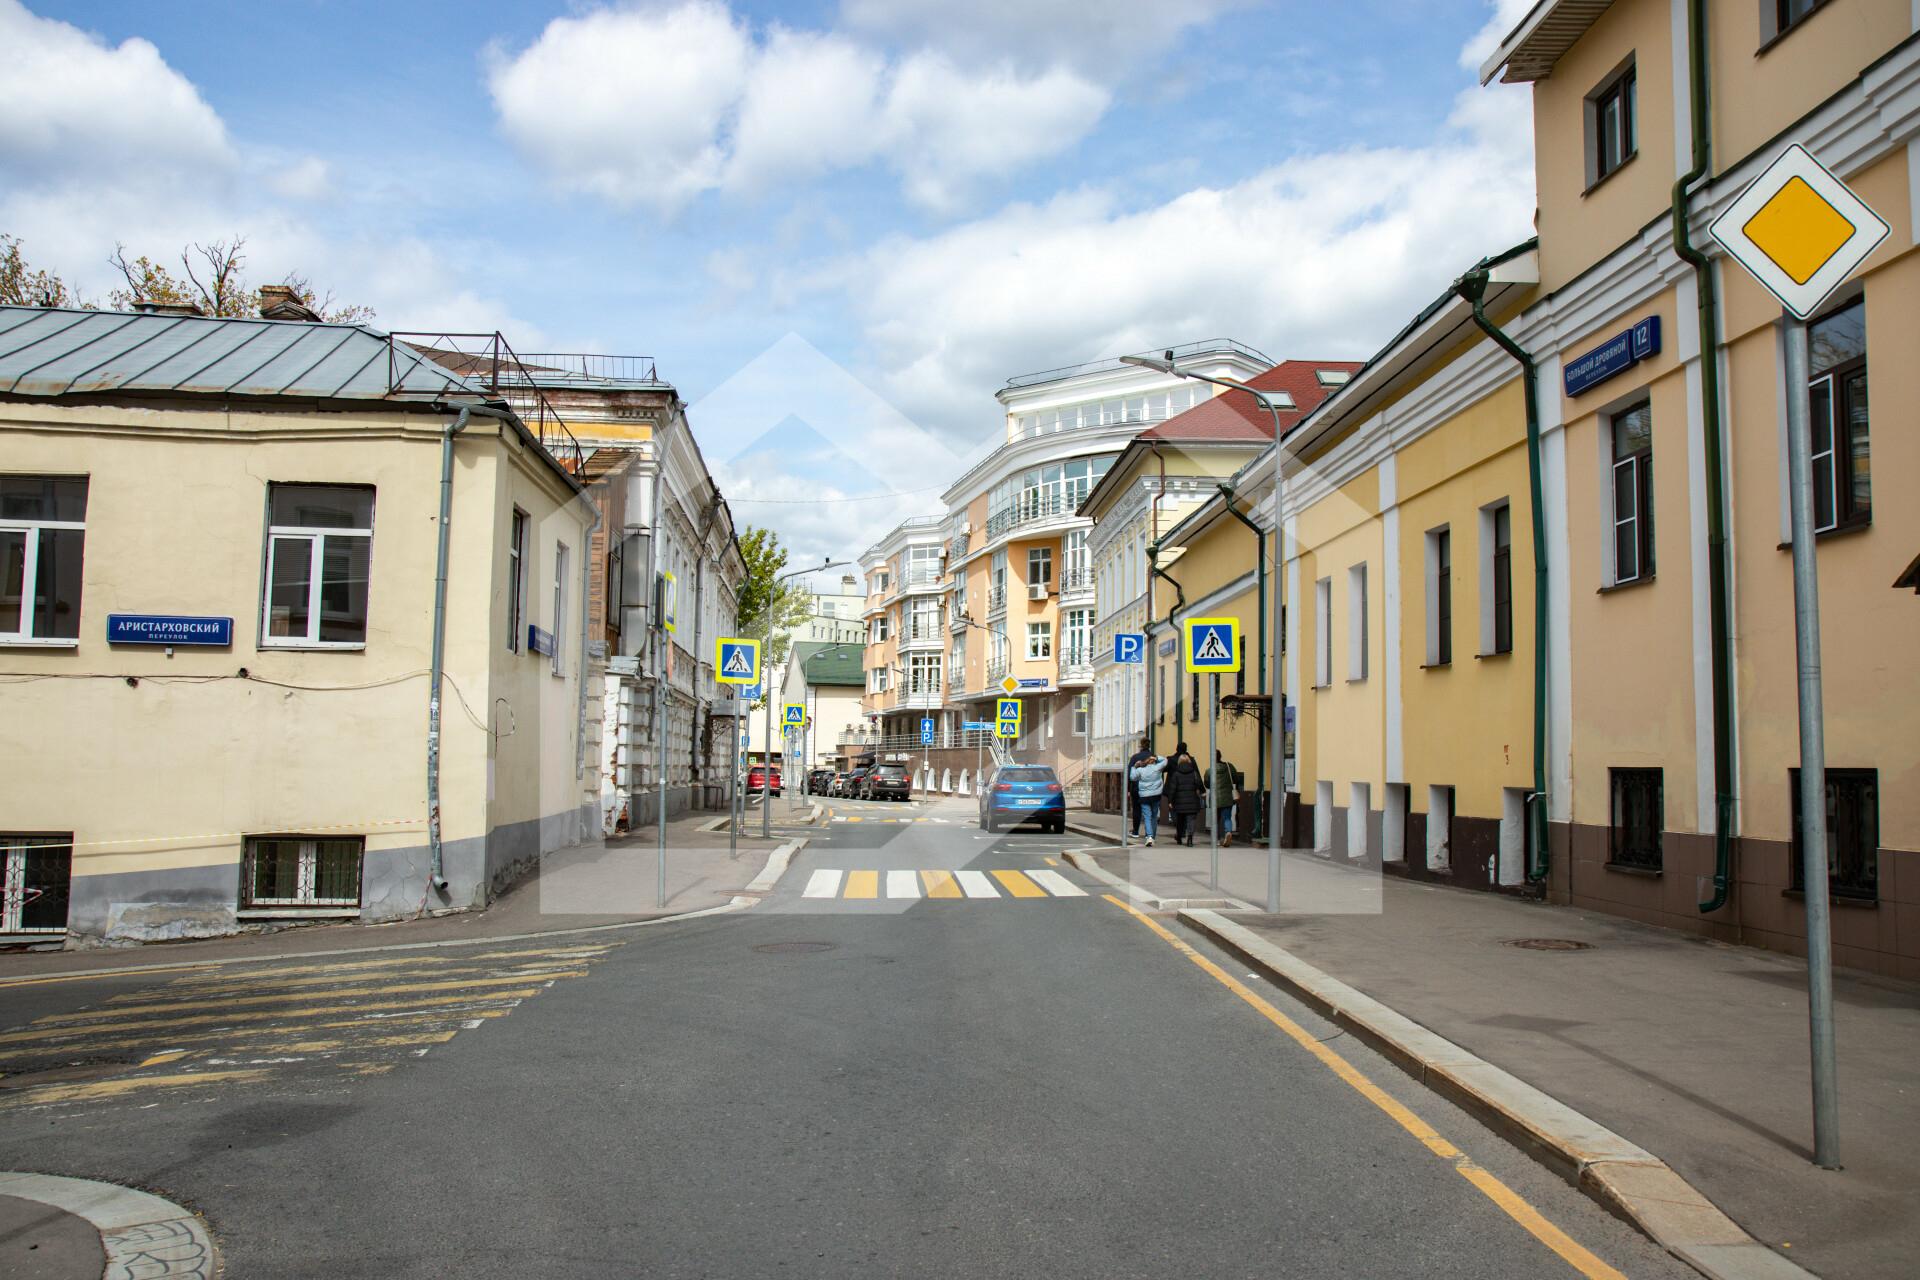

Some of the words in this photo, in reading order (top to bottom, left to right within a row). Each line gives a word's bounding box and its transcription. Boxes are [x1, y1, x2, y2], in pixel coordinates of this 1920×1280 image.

[1637, 326, 1647, 346] 12
[1567, 357, 1594, 382] БОЛЬШОЙ
[1594, 339, 1626, 367] ДРОВЯНОЙ
[118, 621, 220, 634] АРИСТАРХОВСКИЙ
[1121, 637, 1138, 660] P
